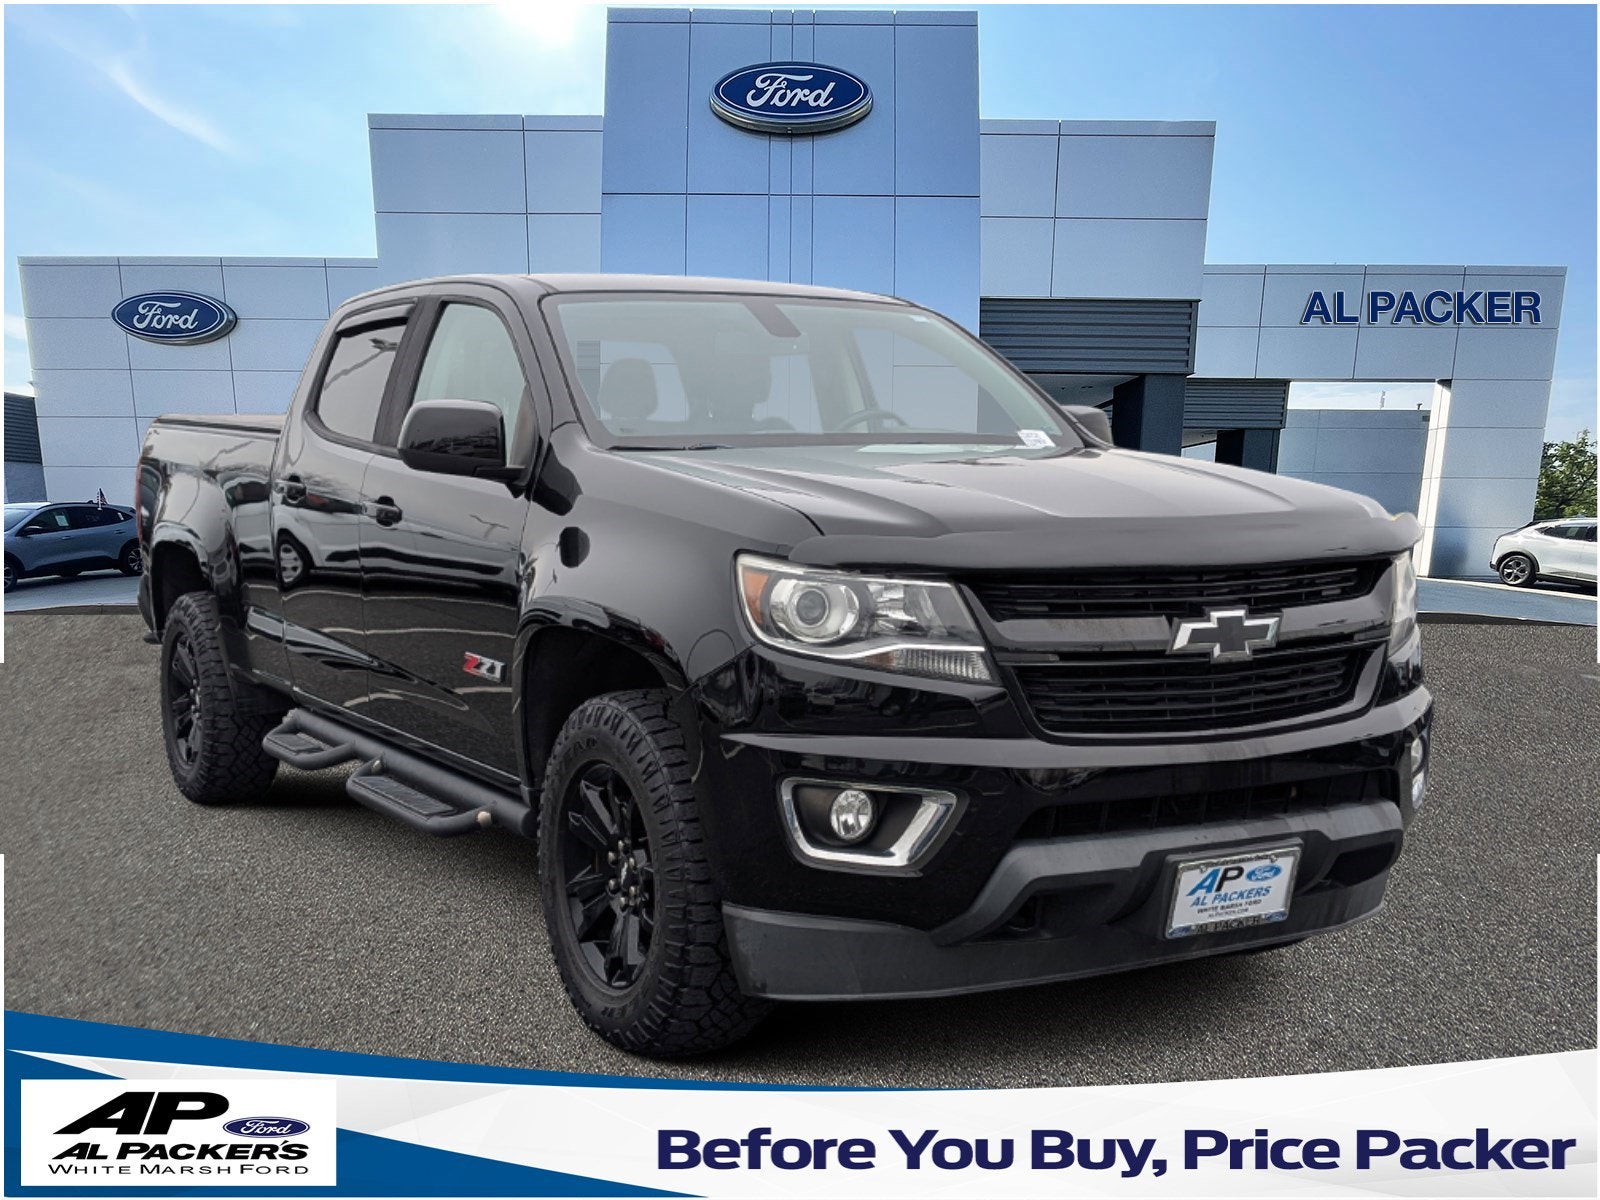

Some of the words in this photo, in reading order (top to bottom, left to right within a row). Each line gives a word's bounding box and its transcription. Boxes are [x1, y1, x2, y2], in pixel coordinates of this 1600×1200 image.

[746, 72, 836, 107] Ford
[133, 301, 199, 329] Ford
[1301, 290, 1360, 324] AL
[1368, 289, 1542, 324] PACKER
[463, 651, 506, 682] Z71
[1186, 865, 1245, 897] AP
[1190, 896, 1208, 907] AL
[1211, 886, 1272, 905] PACKERS
